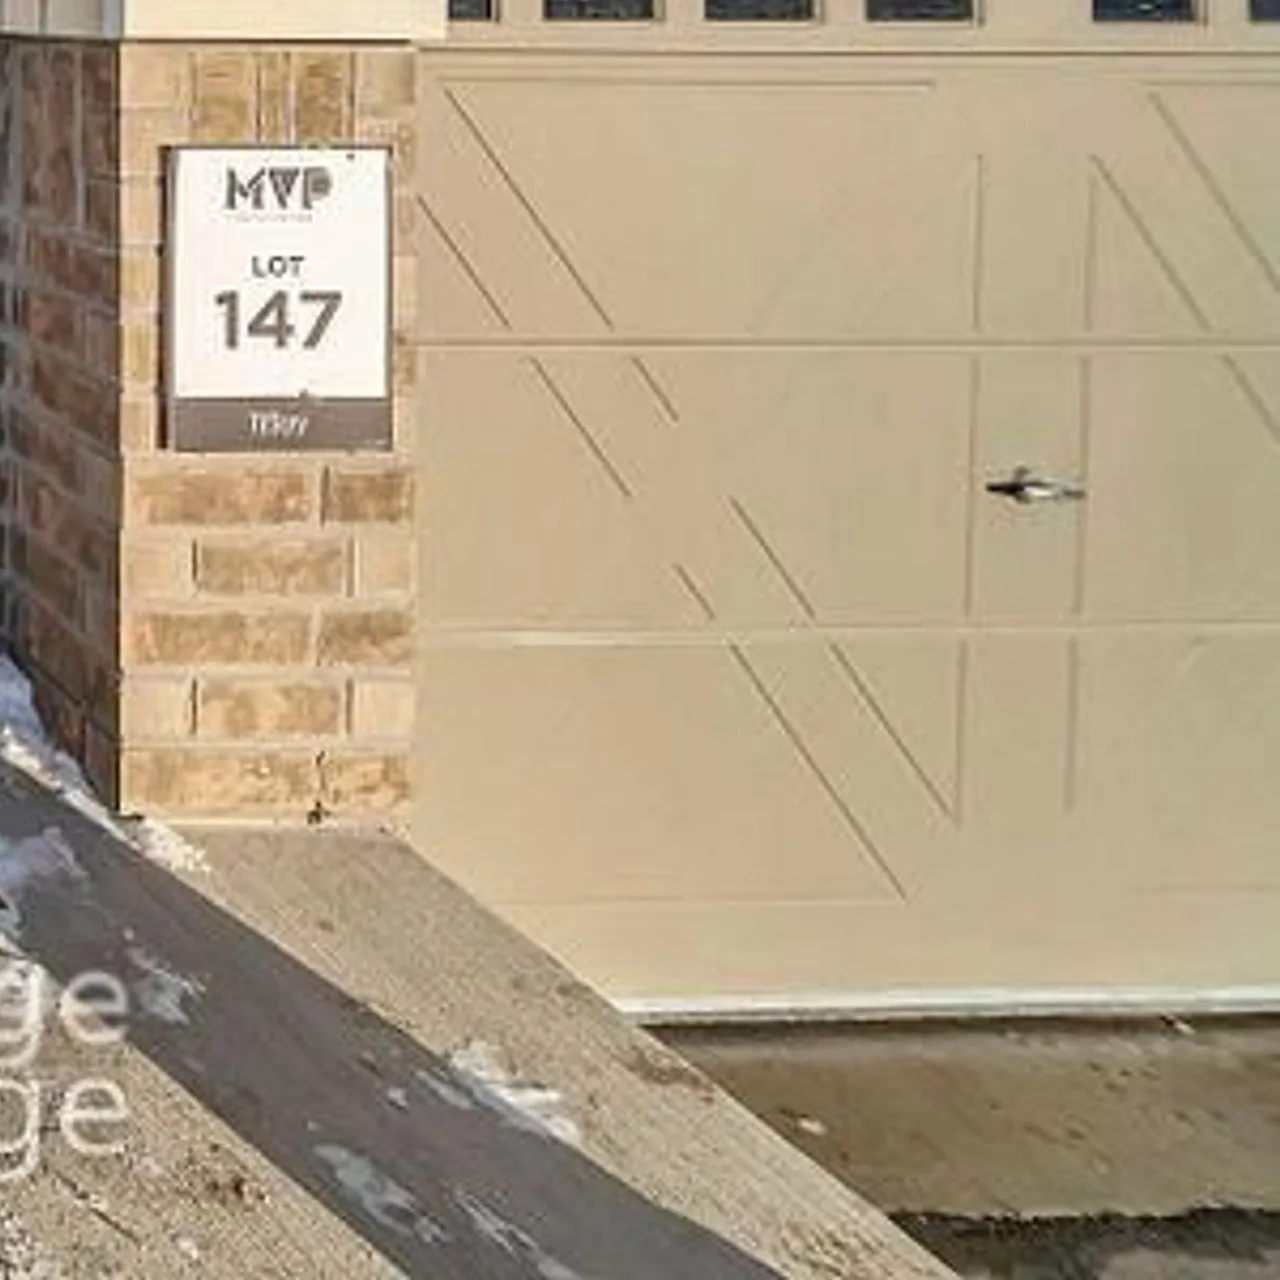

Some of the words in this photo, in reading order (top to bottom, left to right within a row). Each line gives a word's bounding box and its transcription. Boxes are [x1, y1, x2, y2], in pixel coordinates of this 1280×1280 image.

[225, 167, 331, 210] MVP
[251, 255, 305, 278] LOT
[214, 289, 343, 350] 147
